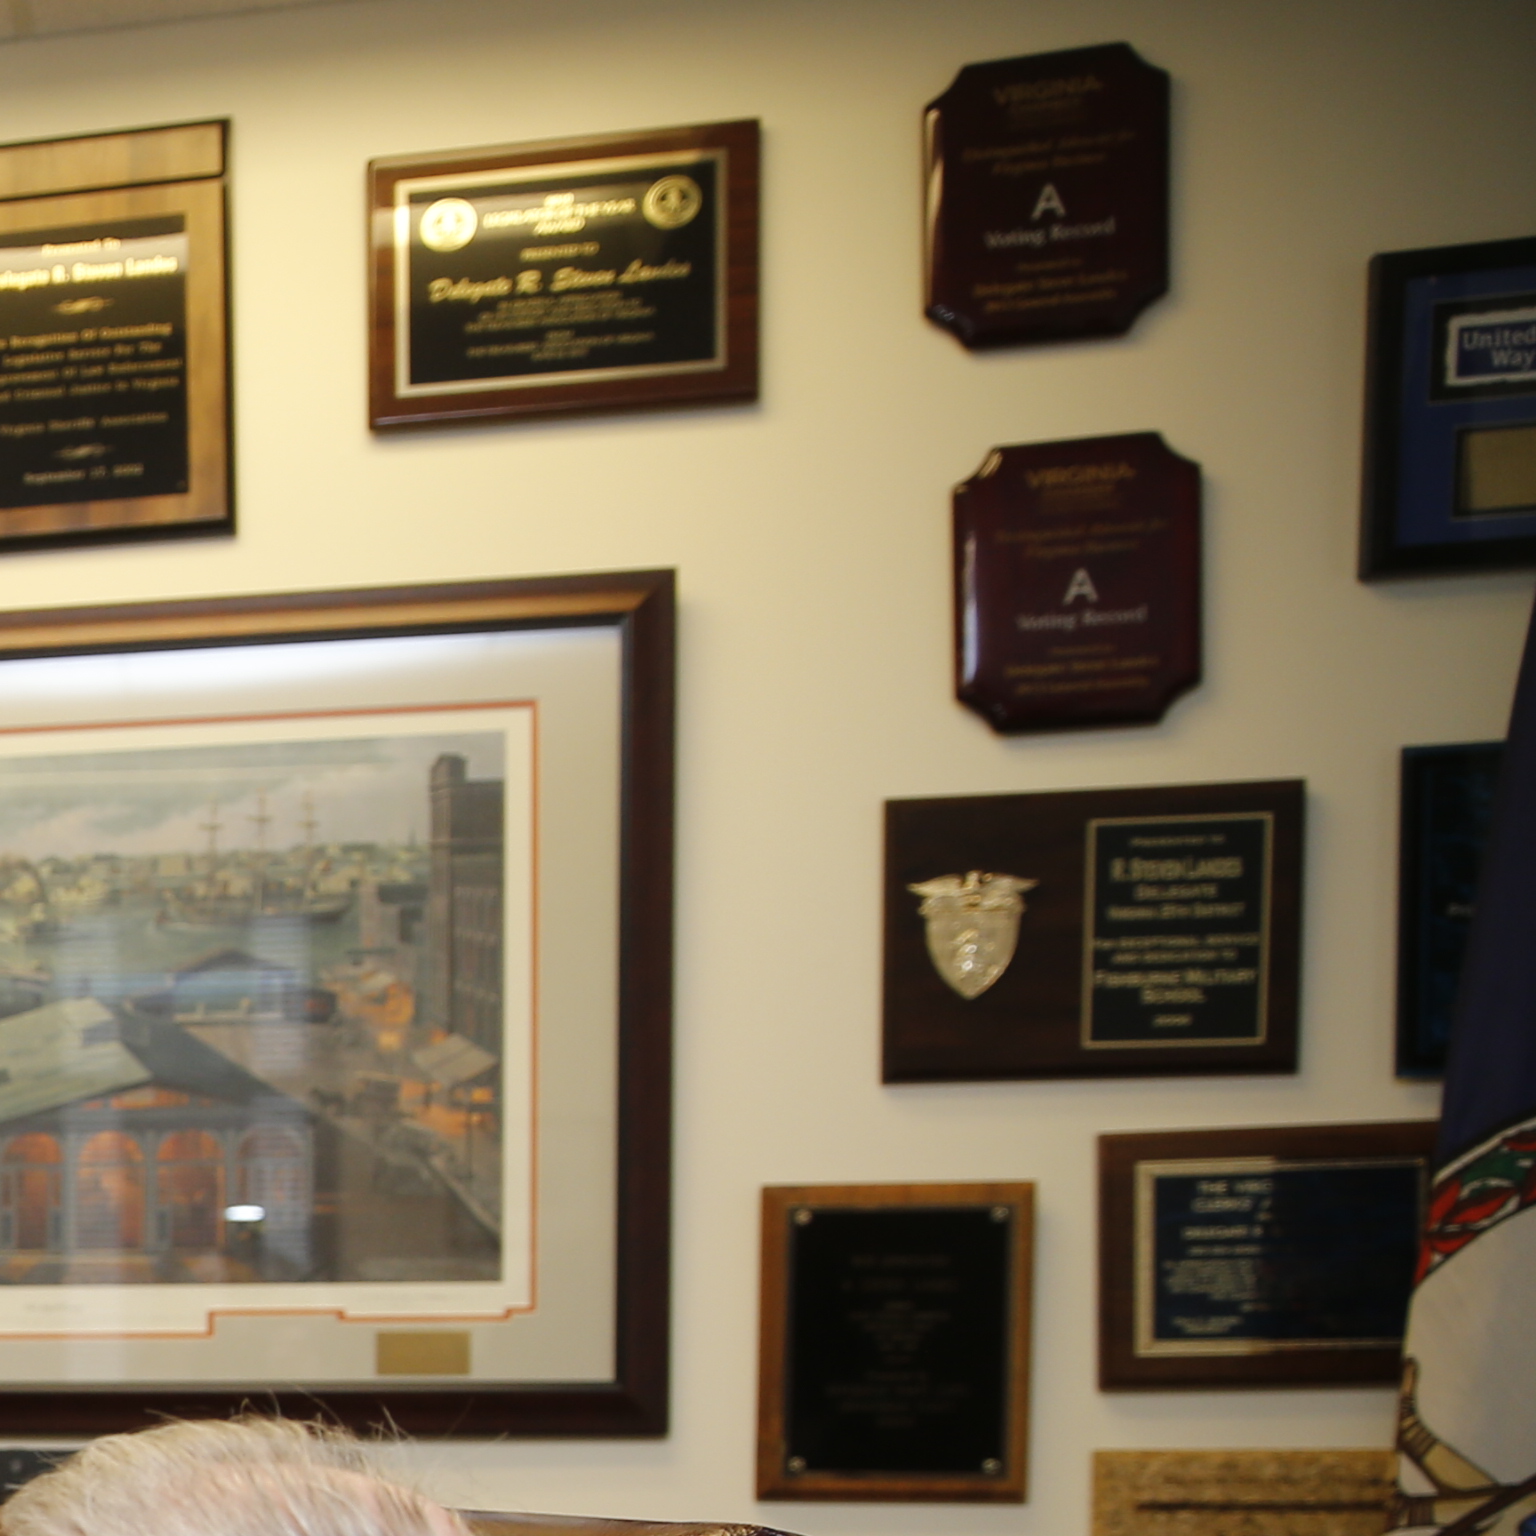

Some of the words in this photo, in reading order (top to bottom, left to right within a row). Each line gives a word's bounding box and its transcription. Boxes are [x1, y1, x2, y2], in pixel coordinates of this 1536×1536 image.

[1031, 182, 1066, 221] A
[984, 227, 1047, 250] Voting
[52, 263, 70, 284] R.
[72, 261, 124, 283] Steven
[126, 254, 178, 276] Landes
[429, 275, 513, 304] Delegate
[550, 266, 616, 292] Steven
[1462, 324, 1536, 351] United
[1491, 347, 1536, 372] Way
[1063, 567, 1099, 606] A
